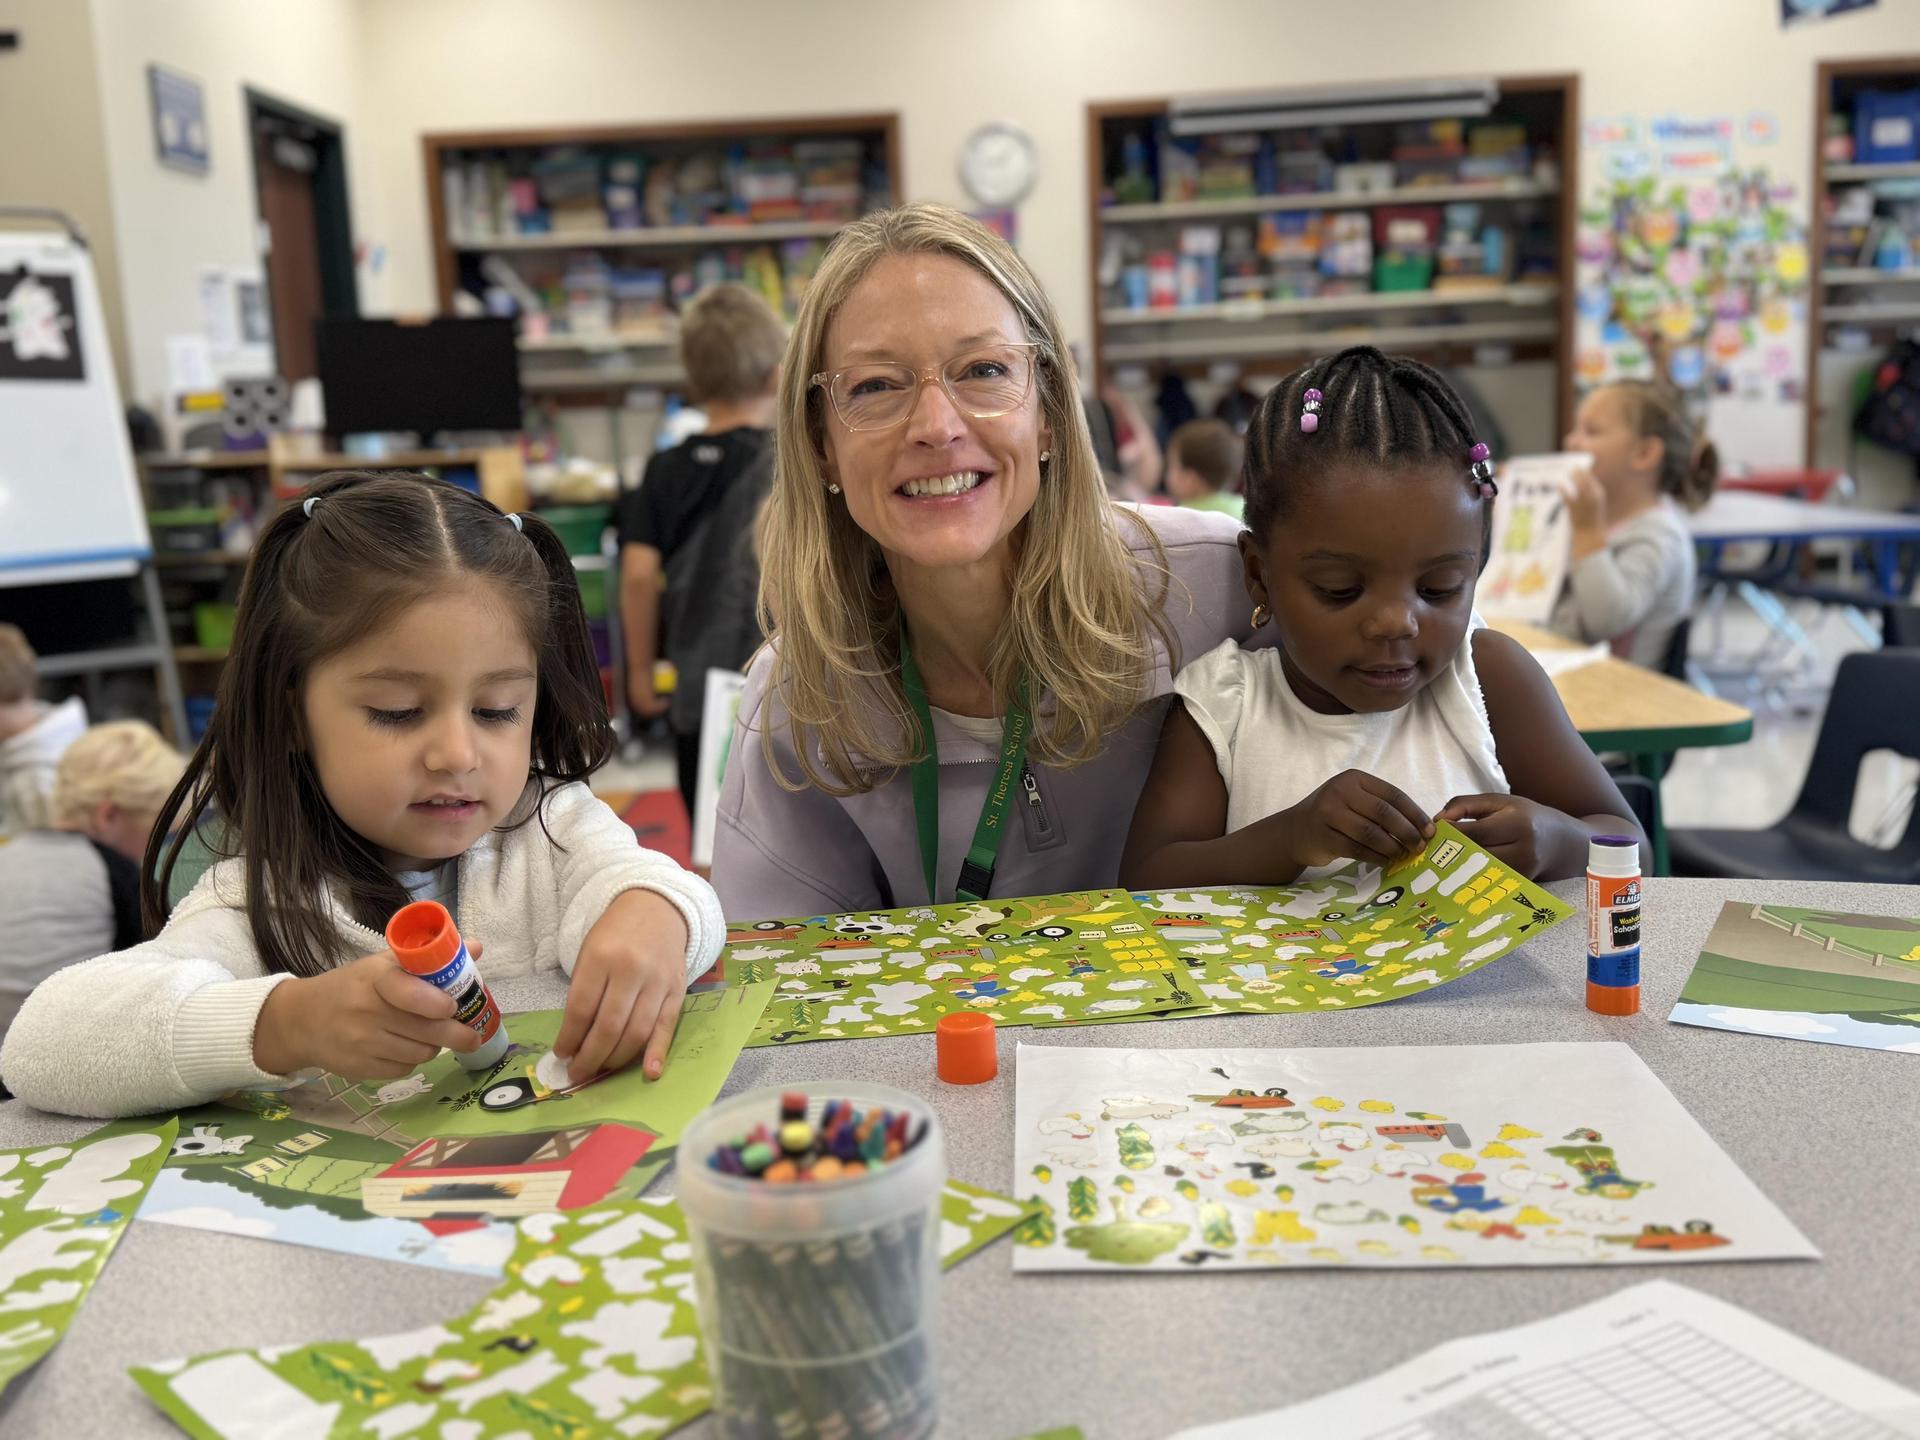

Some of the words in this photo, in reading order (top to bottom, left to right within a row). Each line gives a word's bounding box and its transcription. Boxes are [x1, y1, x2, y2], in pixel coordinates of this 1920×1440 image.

[1006, 714, 1025, 758] School
[992, 761, 1014, 807] Theresa
[986, 812, 1000, 828] St.
